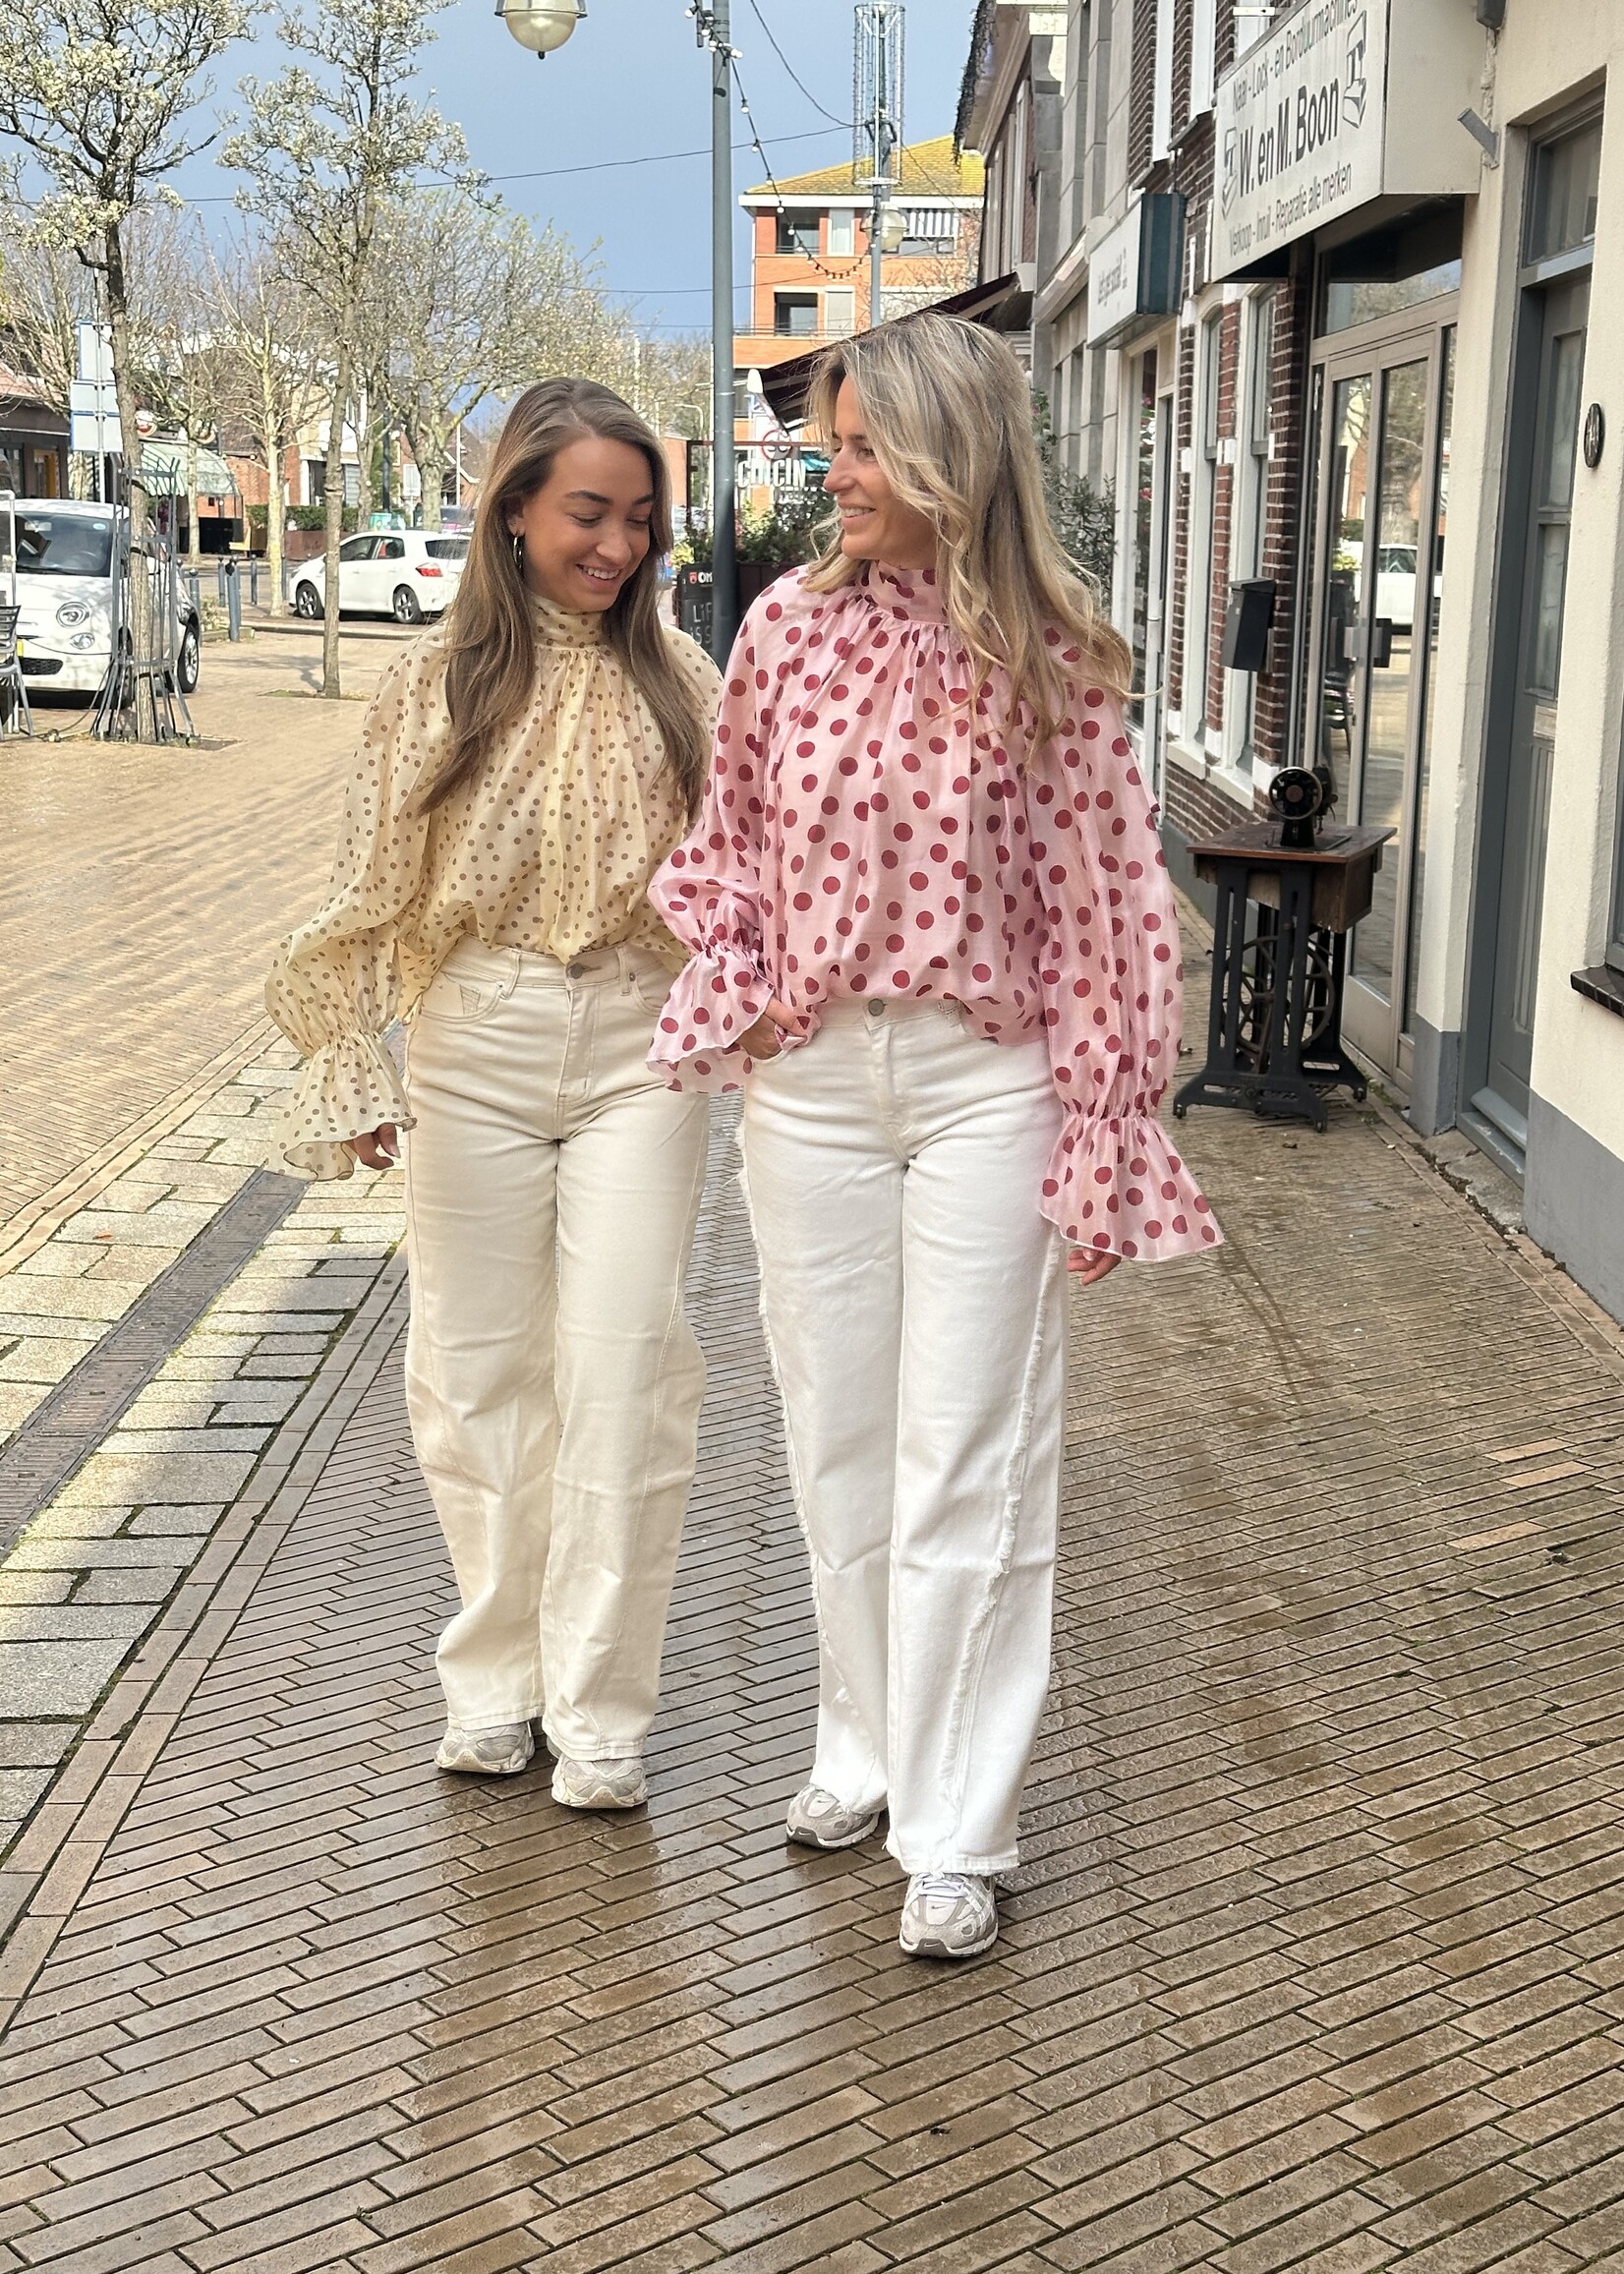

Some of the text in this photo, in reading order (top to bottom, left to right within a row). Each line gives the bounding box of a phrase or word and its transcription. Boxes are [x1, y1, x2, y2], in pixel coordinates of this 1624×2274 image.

[1274, 44, 1285, 79] en
[1240, 78, 1339, 198] W. en M. Boon
[1307, 175, 1321, 214] alle
[1322, 160, 1352, 206] merken
[698, 571, 713, 584] OM
